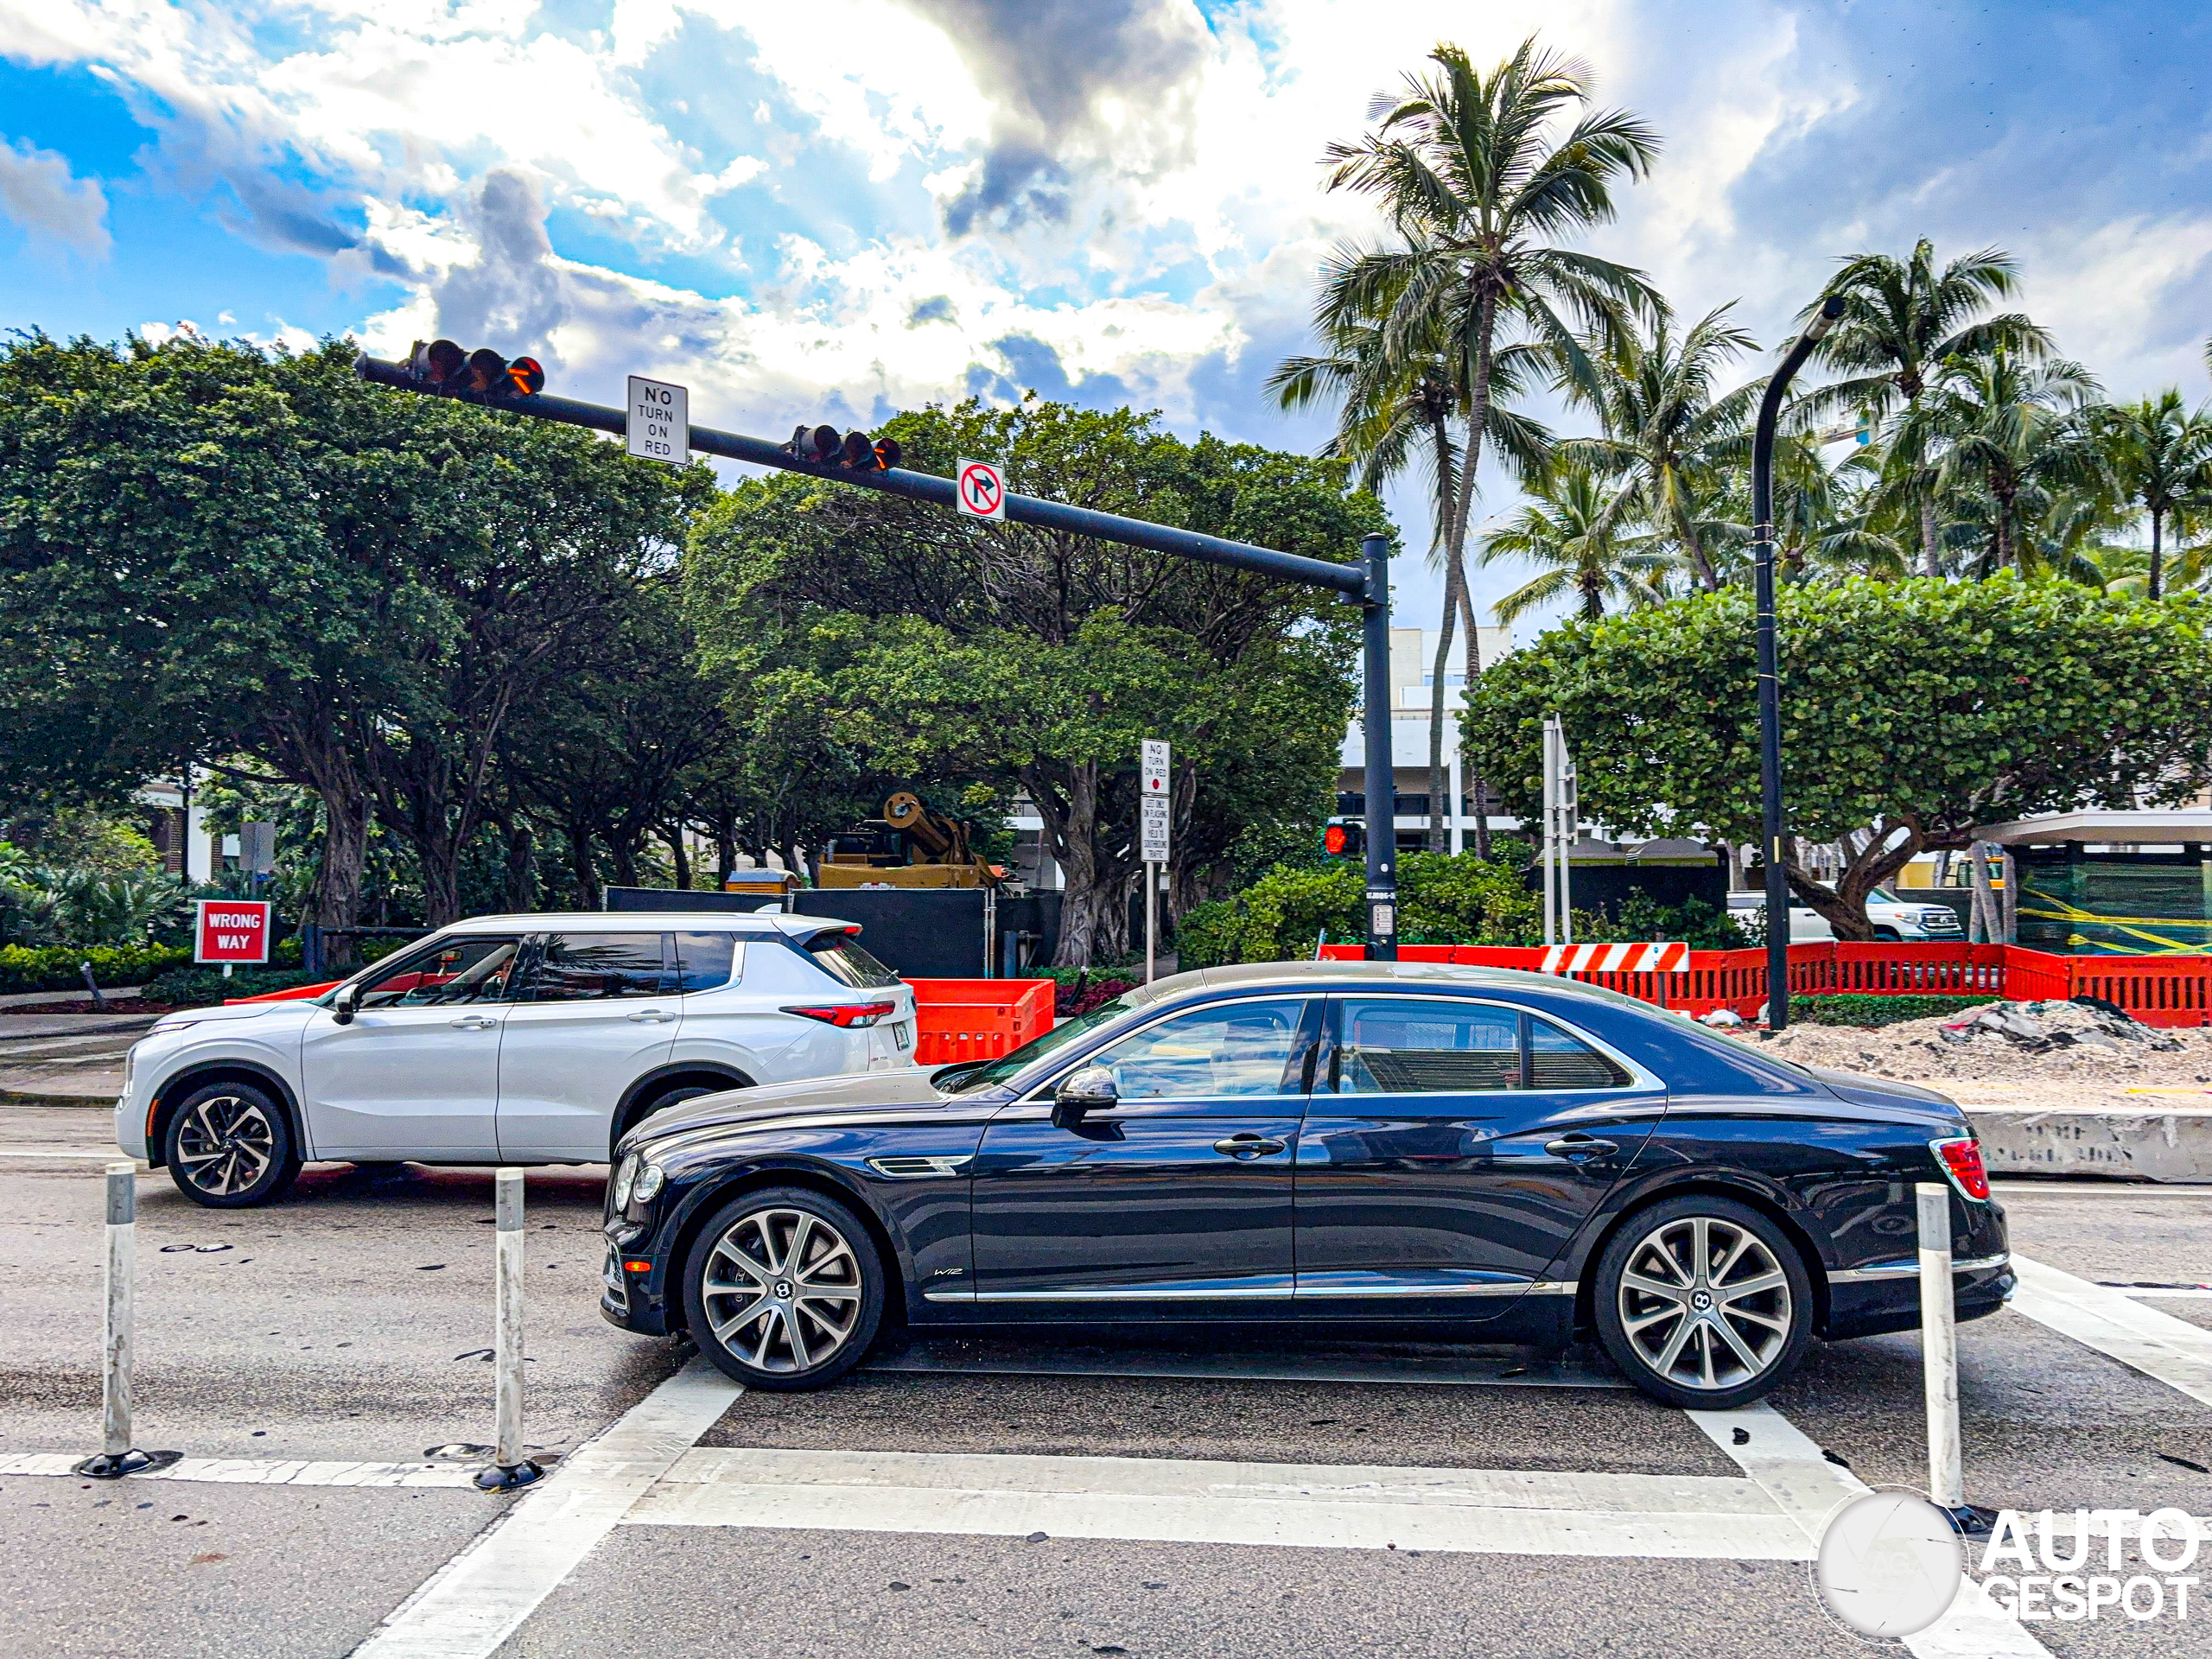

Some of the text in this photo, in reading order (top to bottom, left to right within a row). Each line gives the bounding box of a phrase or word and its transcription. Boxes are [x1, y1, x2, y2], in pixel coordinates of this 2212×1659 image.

[645, 386, 672, 405] NO
[638, 404, 673, 423] TURN
[648, 423, 667, 439] ON
[645, 440, 671, 455] RED
[1149, 744, 1162, 755] NO
[1147, 756, 1164, 766] TURN
[1145, 766, 1166, 778] ON RED
[208, 912, 261, 929] WRONG
[217, 934, 251, 950] WAY
[934, 1268, 963, 1276] W12
